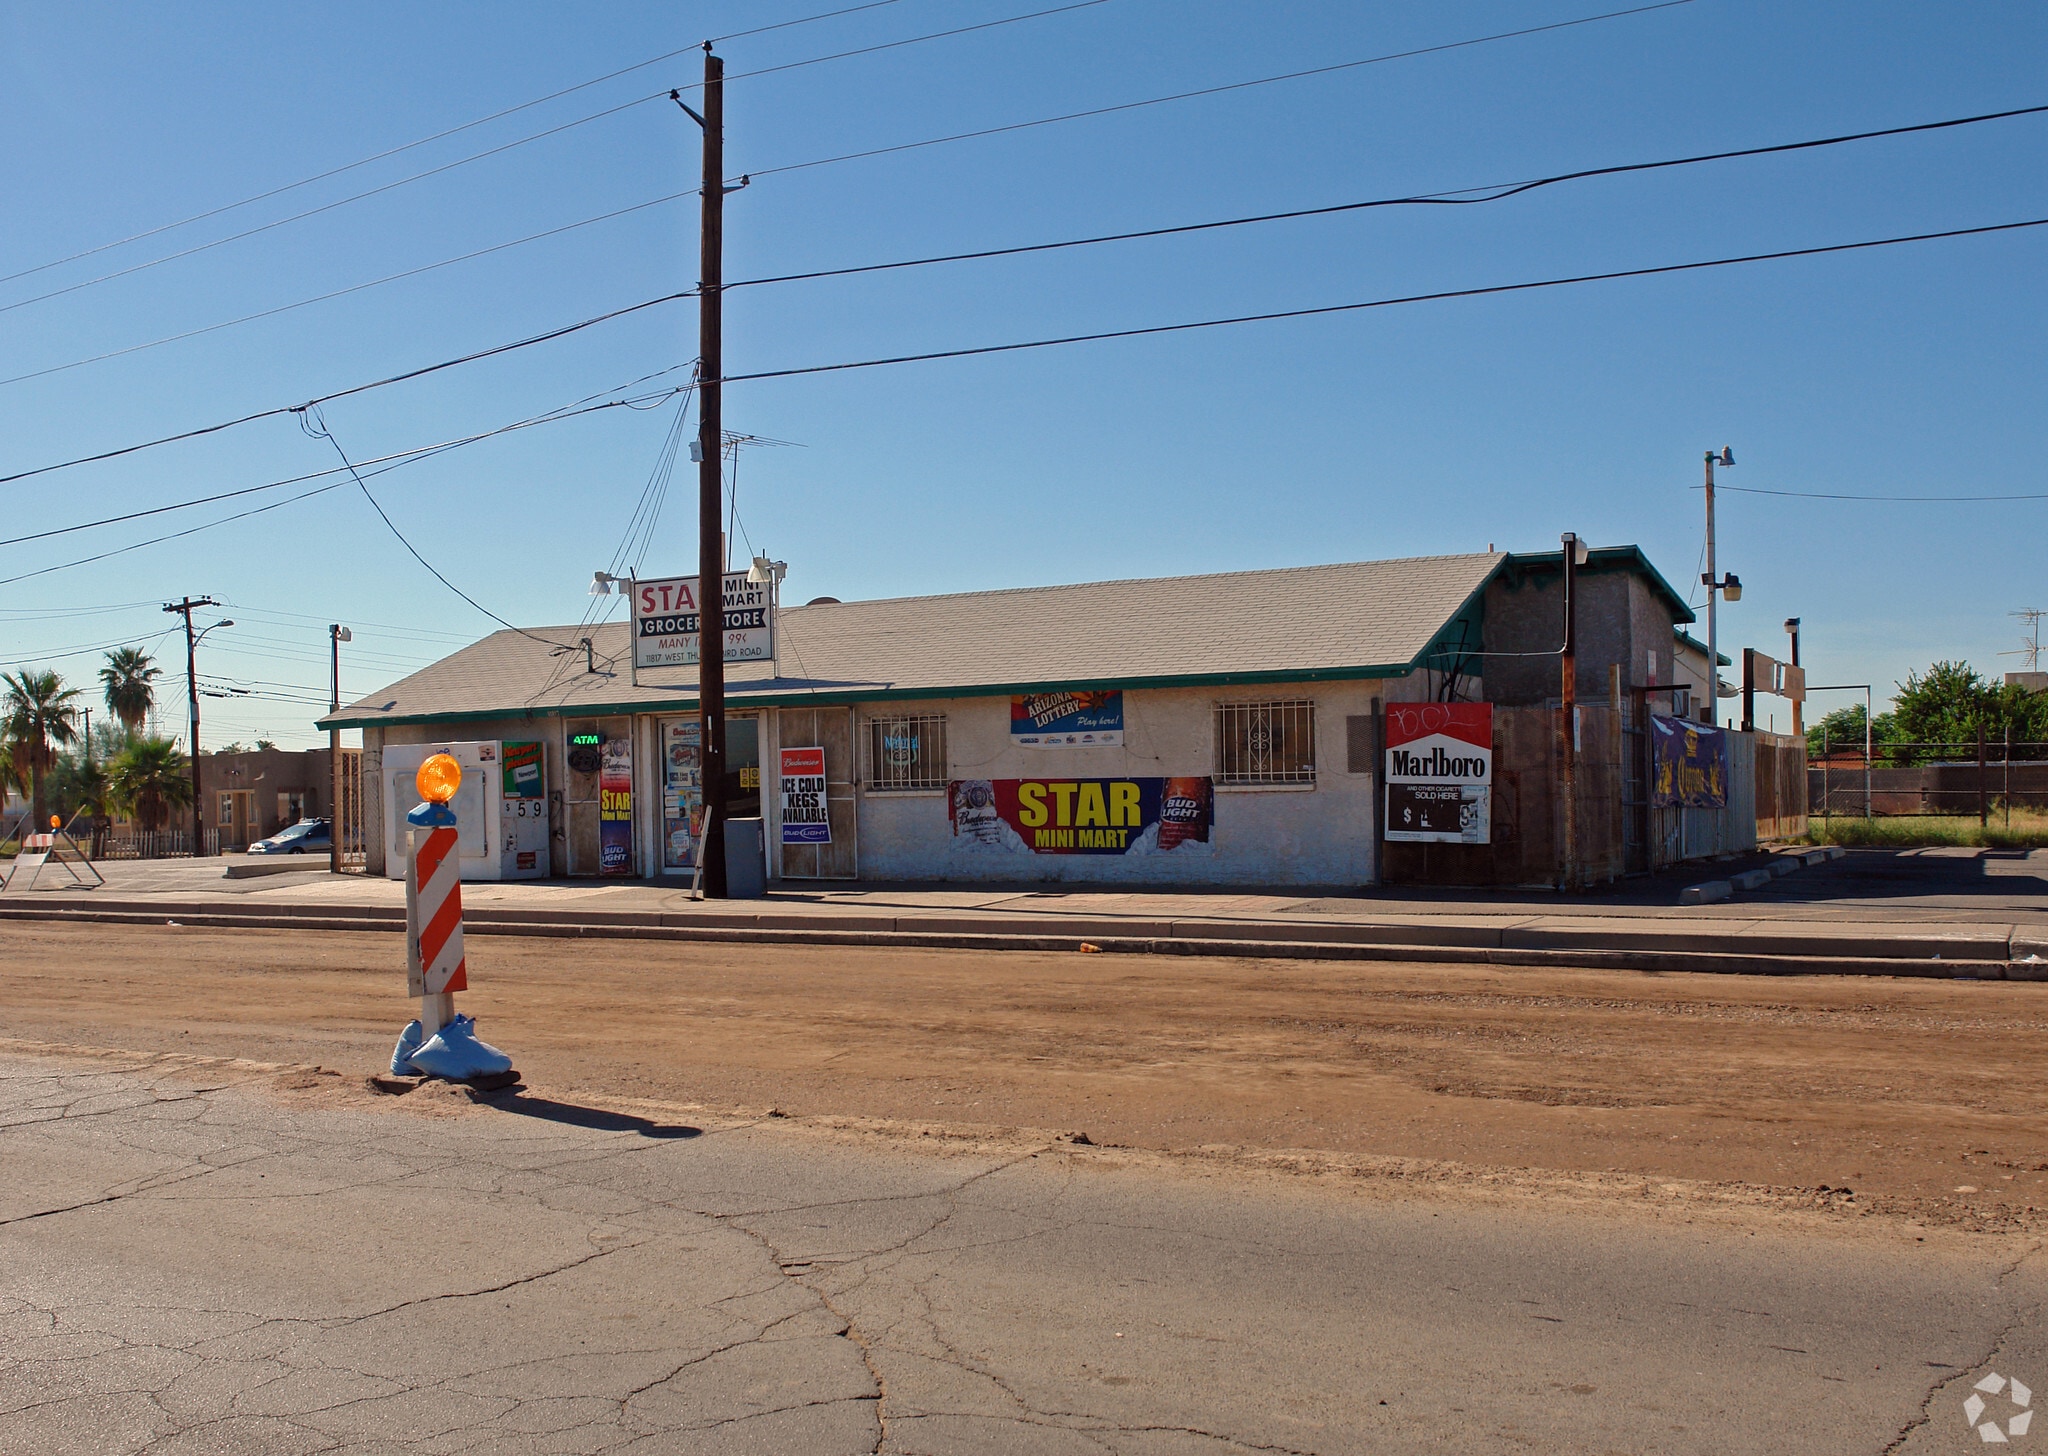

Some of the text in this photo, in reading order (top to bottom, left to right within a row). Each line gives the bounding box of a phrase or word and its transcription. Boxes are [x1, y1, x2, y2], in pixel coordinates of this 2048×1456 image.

[725, 578, 760, 592] MINI
[641, 584, 697, 614] STA
[723, 591, 763, 607] MART
[645, 611, 760, 634] GROCER TORE
[658, 637, 691, 649] MANY
[645, 654, 662, 663] 11817
[665, 653, 684, 662] WEST
[740, 647, 762, 656] ROAD
[1027, 691, 1073, 718] ARIZONA
[1033, 699, 1081, 729] LOTTERY
[1077, 716, 1098, 728] Play
[573, 735, 599, 745] ATM
[783, 757, 820, 768] Budweiser
[1391, 747, 1486, 778] Marlboro
[782, 777, 825, 793] ICE COLD
[601, 789, 631, 810] STAR
[788, 793, 819, 808] KEGS
[1415, 791, 1459, 800] SOLD HERE
[1018, 782, 1142, 827] STAR
[1166, 799, 1197, 809] BUD
[782, 807, 827, 823] AVAILABLE
[1162, 807, 1200, 818] LIGHT
[1035, 829, 1128, 848] MINI MART
[604, 846, 624, 855] BUD
